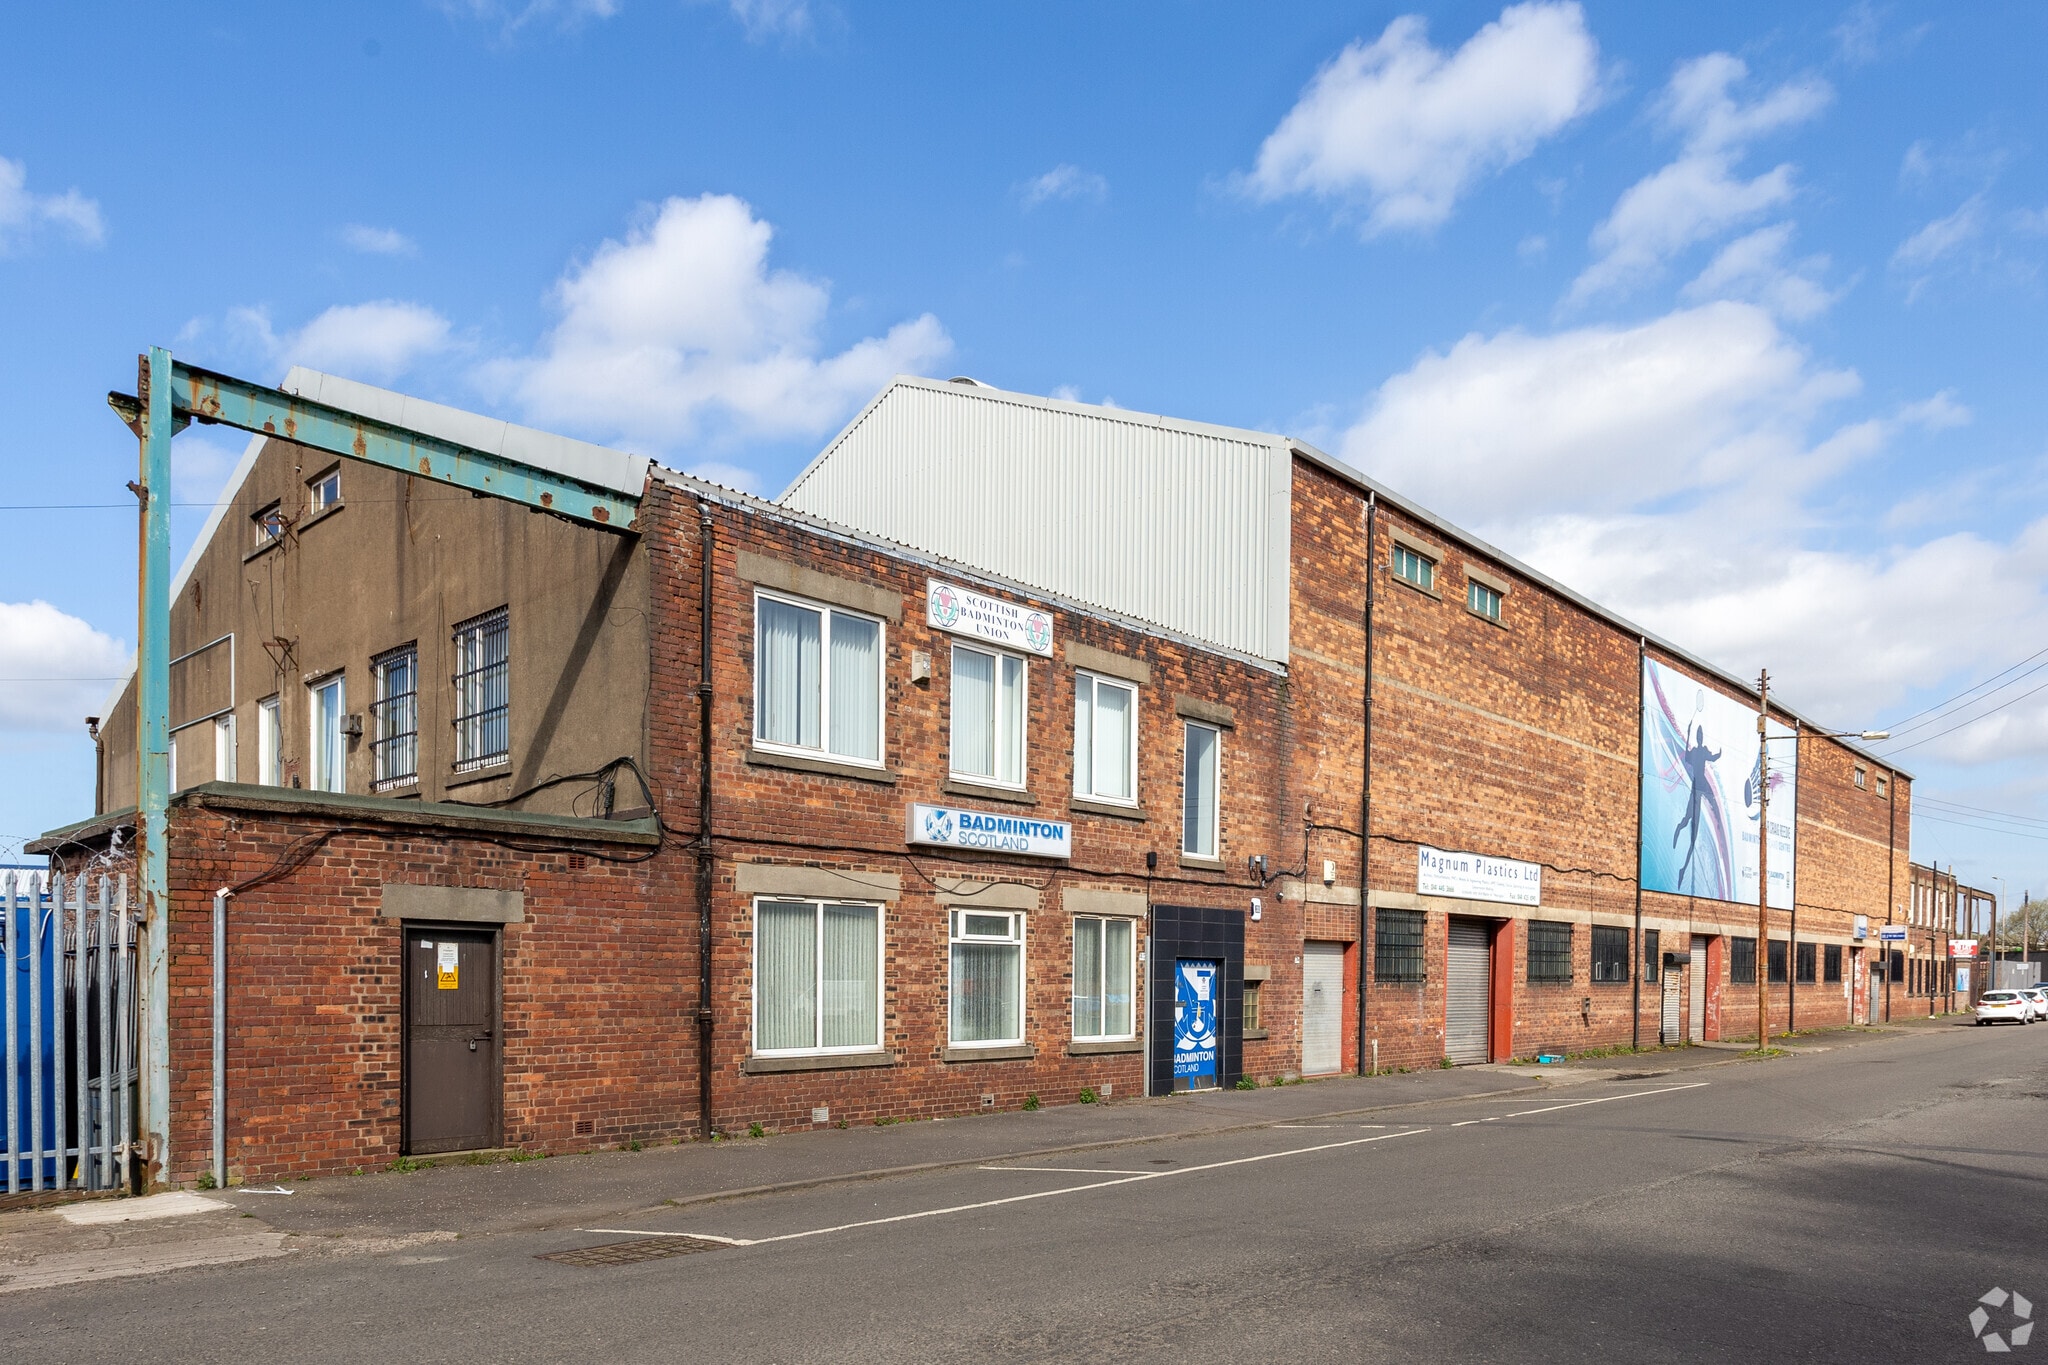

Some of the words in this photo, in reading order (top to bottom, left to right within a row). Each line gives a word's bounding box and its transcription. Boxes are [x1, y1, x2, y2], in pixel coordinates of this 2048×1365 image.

[960, 606, 1024, 632] BADMINTON
[966, 595, 1018, 619] SCOTTISH
[976, 623, 1009, 640] UNION
[959, 813, 1063, 840] BADMINTON
[958, 831, 1029, 850] SCOTLAND
[1421, 851, 1468, 873] Magnum
[1476, 858, 1518, 879] Plastics
[1524, 866, 1538, 882] Ltd
[1174, 1064, 1199, 1074] COTLAND
